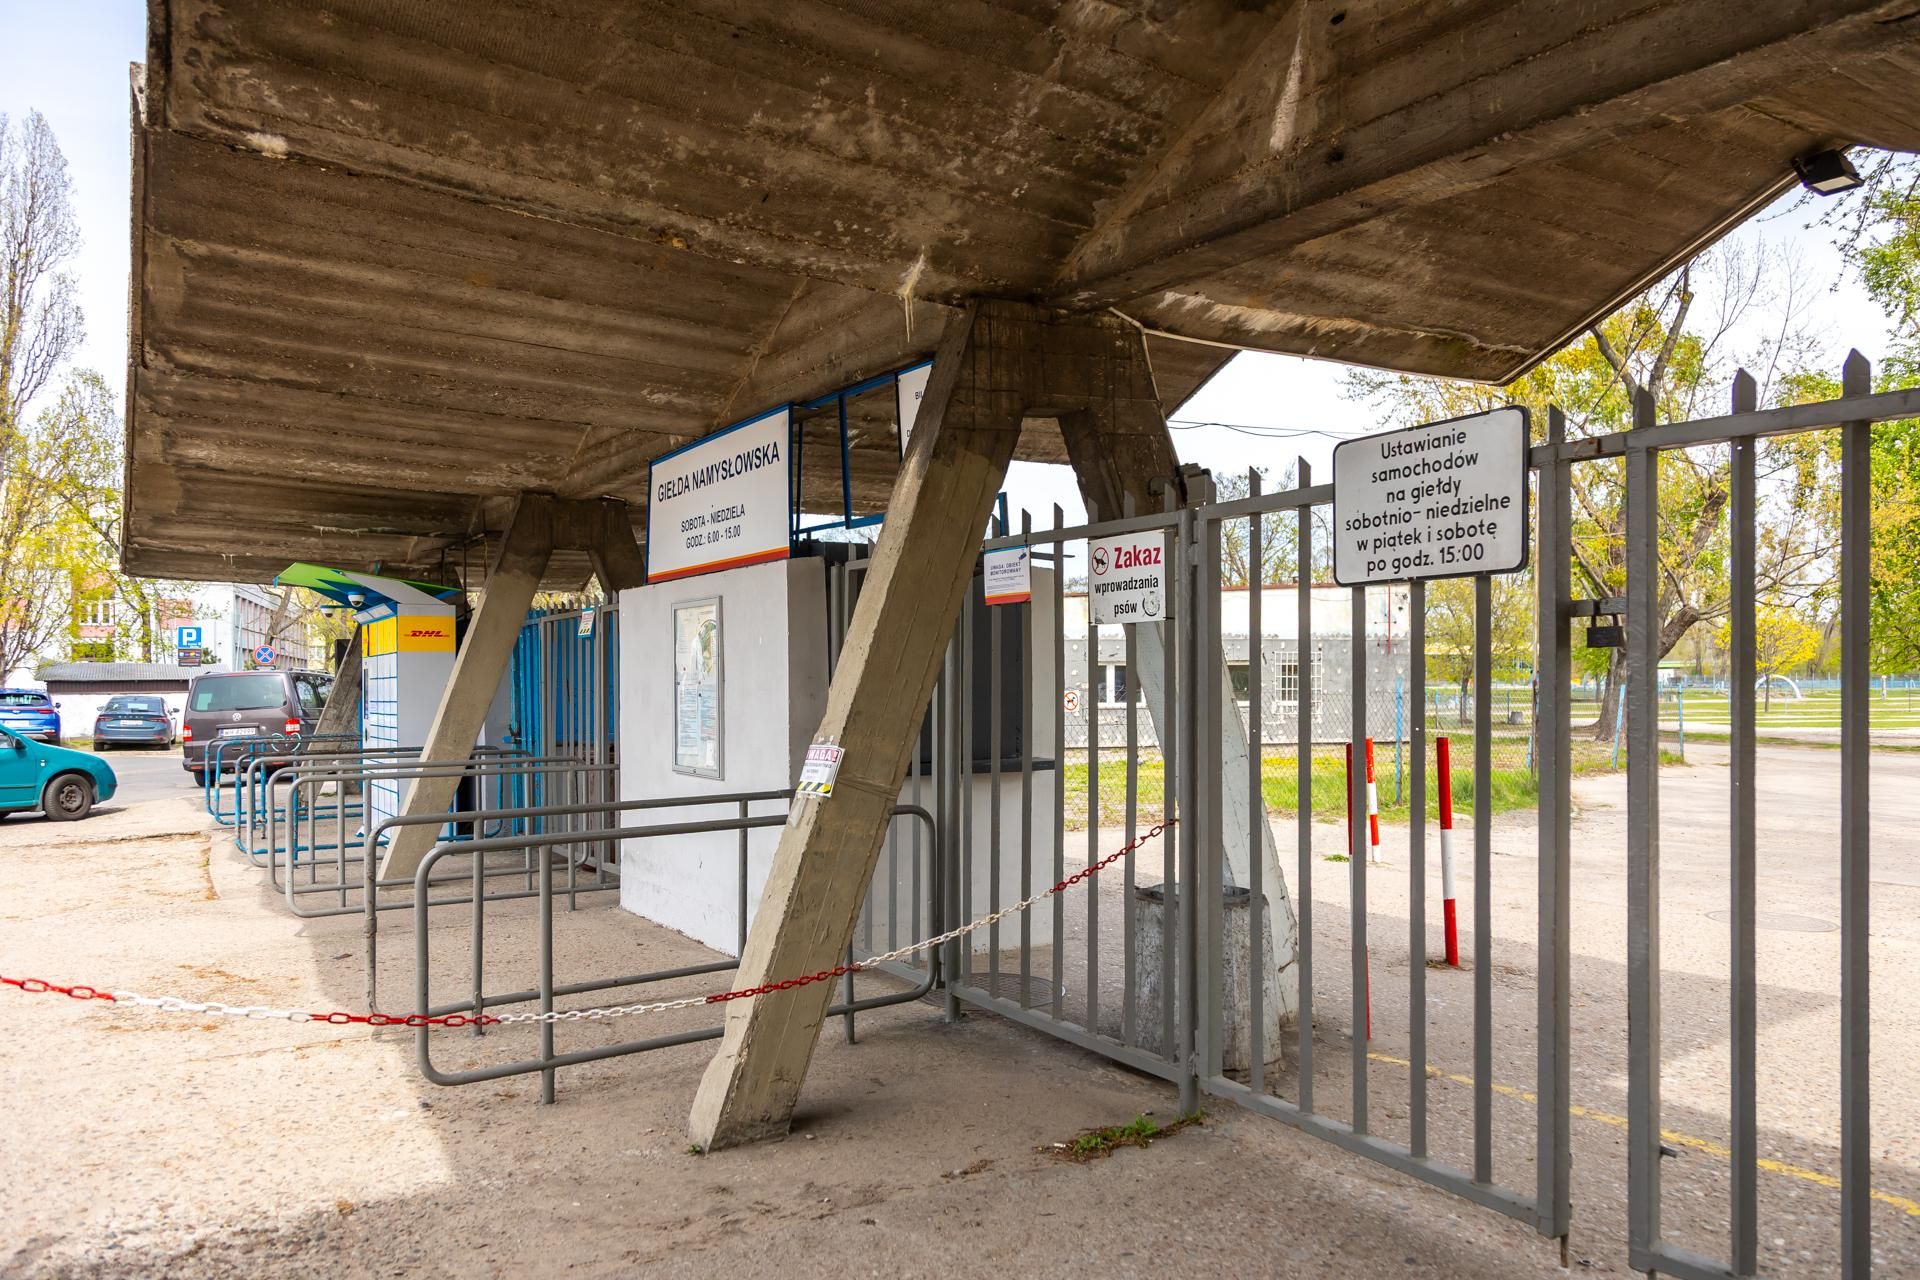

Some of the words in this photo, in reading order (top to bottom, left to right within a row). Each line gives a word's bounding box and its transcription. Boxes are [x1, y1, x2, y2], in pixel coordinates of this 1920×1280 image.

[1381, 428, 1467, 459] Ustawianie
[657, 474, 691, 502] GIEŁDA
[692, 441, 780, 491] NAMYSŁOWSKA
[1372, 450, 1479, 483] samochodów
[1386, 489, 1405, 503] na
[1411, 476, 1462, 504] giełdy
[681, 515, 706, 533] SOBOTA
[710, 503, 746, 524] NIEDZIELA
[1426, 494, 1511, 520] niedzielne
[707, 530, 720, 544] 6.00
[724, 524, 741, 539] 15.00
[1356, 539, 1369, 551] w
[1373, 528, 1422, 554] piątek
[1427, 526, 1431, 542] i
[1436, 519, 1497, 540] sobotę
[1114, 544, 1161, 569] Zakaz
[1367, 559, 1387, 577] po
[1391, 549, 1434, 574] godz.
[1439, 543, 1484, 564] 15:00
[1094, 574, 1159, 596] wprowadzania
[1114, 600, 1138, 617] psów
[182, 628, 197, 646] P
